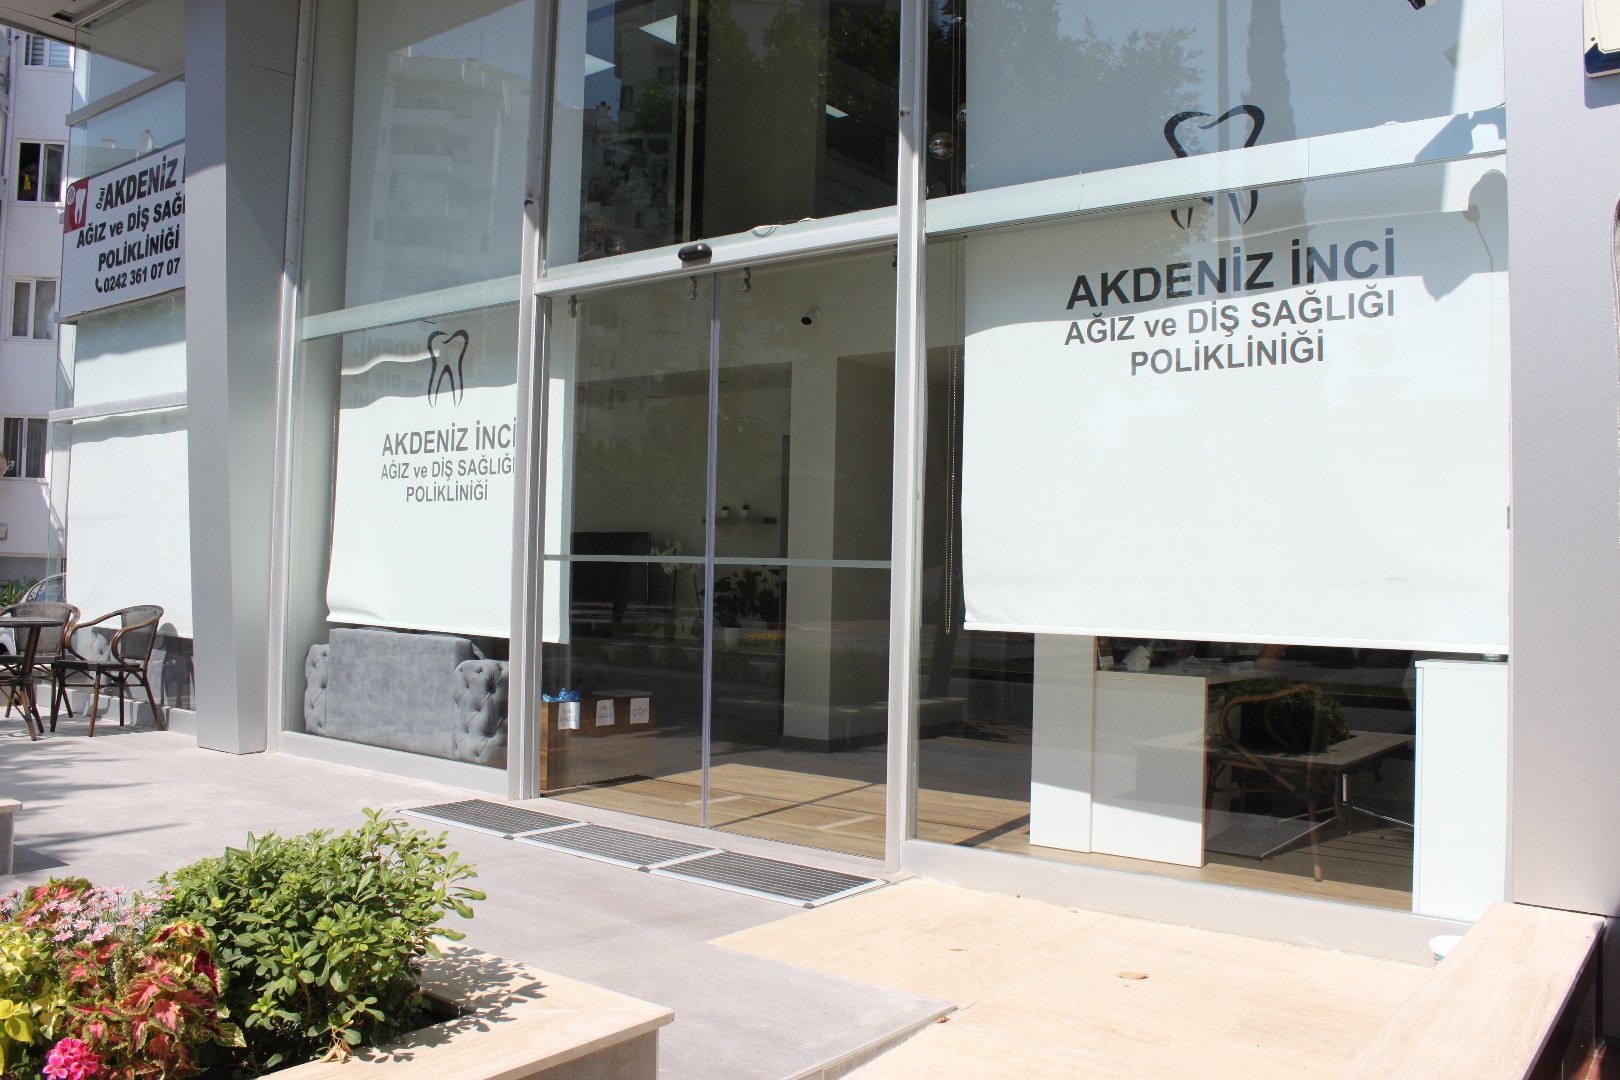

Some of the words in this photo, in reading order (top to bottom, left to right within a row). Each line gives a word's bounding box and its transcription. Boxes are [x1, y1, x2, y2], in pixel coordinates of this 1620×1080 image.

[103, 155, 178, 211] AKDENİZ
[77, 222, 106, 248] AĞIZ
[110, 221, 123, 237] ve
[127, 205, 149, 232] DİŞ
[153, 191, 185, 223] SAĞ
[98, 224, 180, 271] POLİKLİNİĞİ
[1066, 246, 1274, 310] AKDENİZ
[1291, 228, 1395, 286] İNCİ
[104, 272, 127, 293] 0242
[130, 266, 147, 285] 361
[151, 262, 164, 280] 07
[167, 257, 180, 276] 07
[1064, 312, 1135, 346] AĞIZ
[1144, 317, 1177, 337] ve
[1188, 300, 1240, 337] DİŞ
[1251, 283, 1395, 328] SAĞLIĞI
[1131, 329, 1324, 376] POLİKLİNİĞİ
[382, 422, 468, 456] AKDENİZ
[475, 417, 516, 450] İNCİ
[381, 460, 410, 479] AĞIZ
[414, 466, 427, 478] ve
[432, 457, 453, 481] DİŞ
[406, 479, 488, 502] POLİKLİNİĞİ
